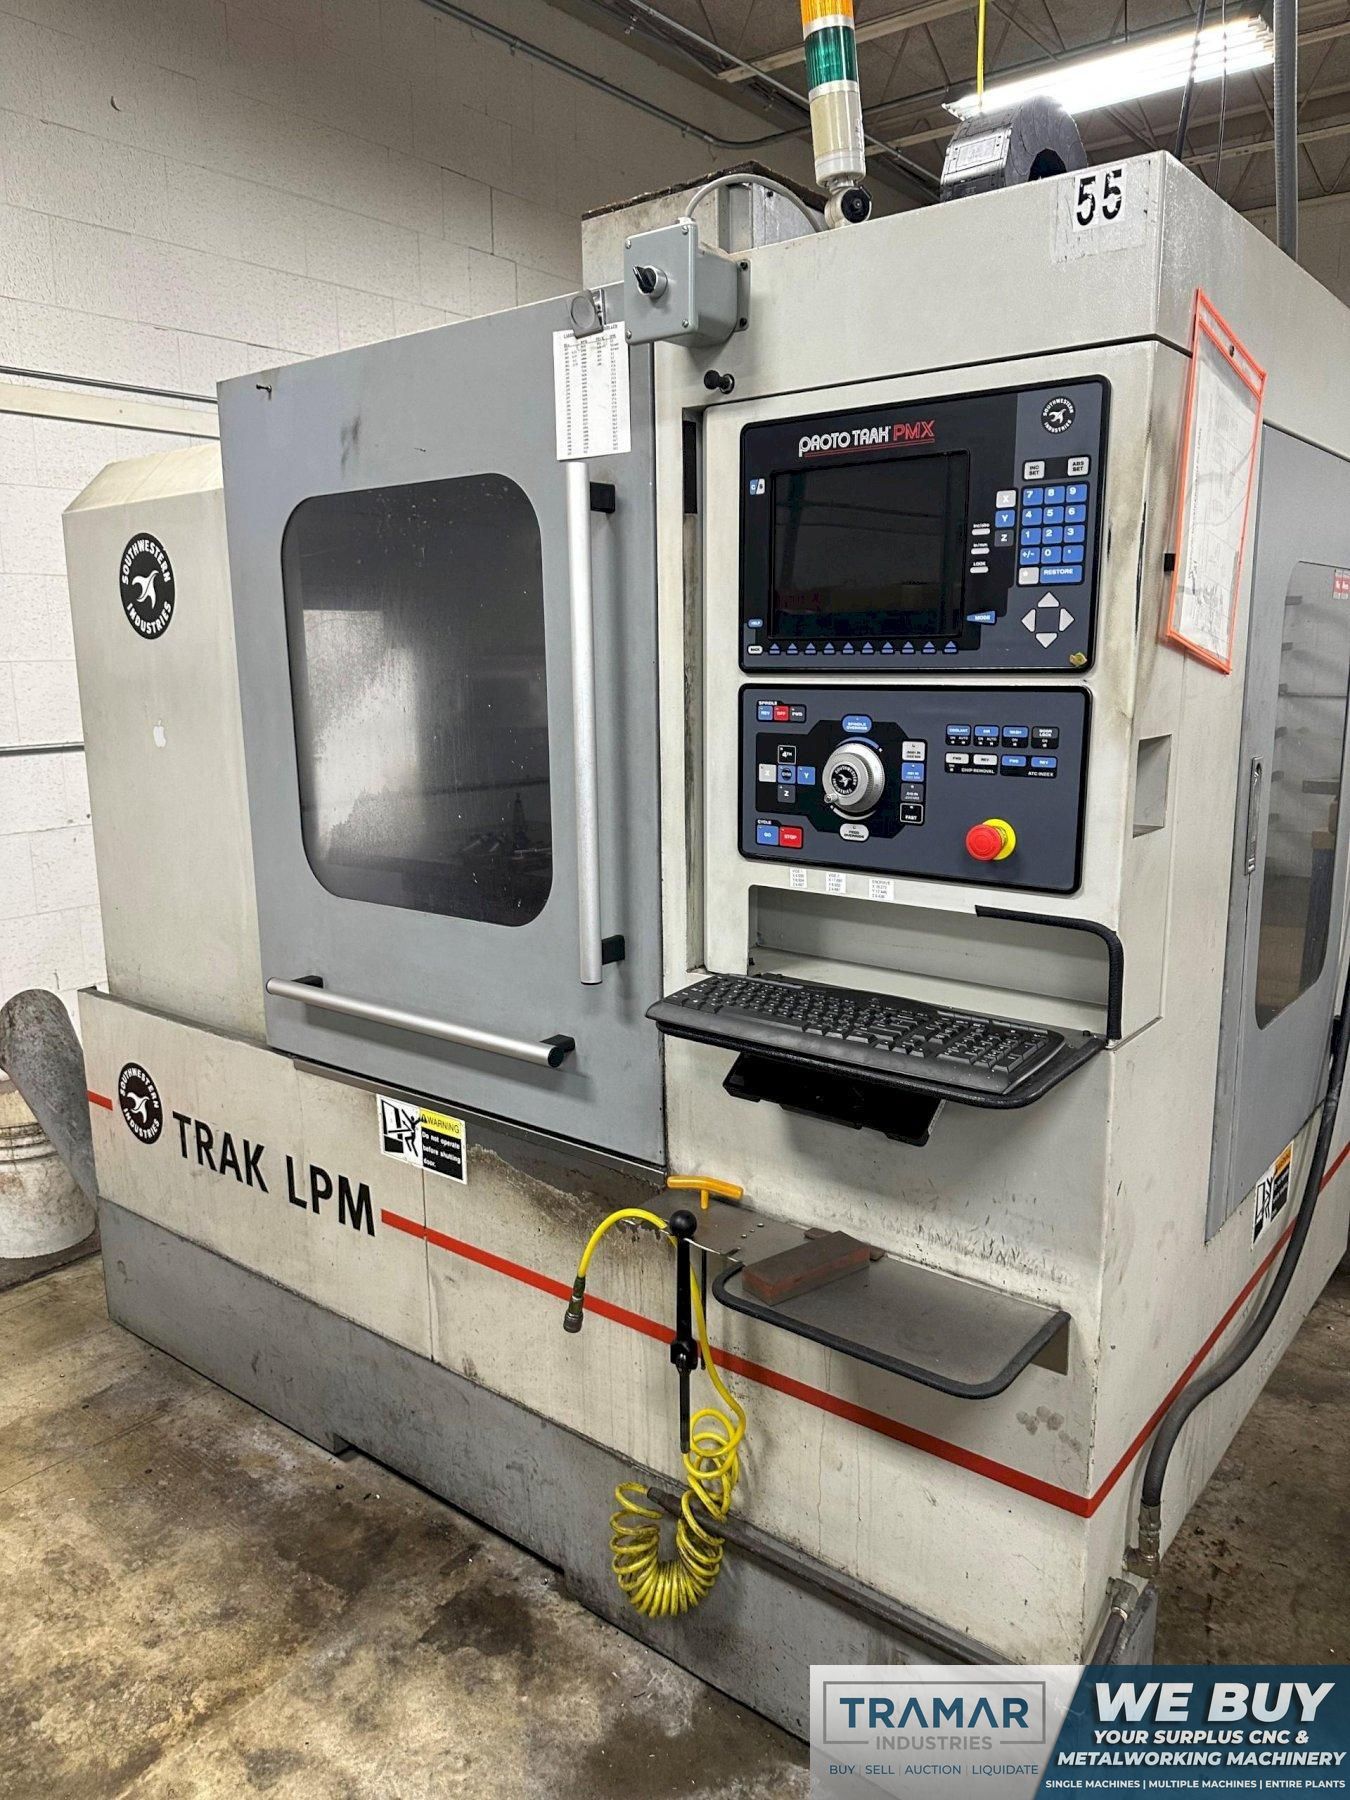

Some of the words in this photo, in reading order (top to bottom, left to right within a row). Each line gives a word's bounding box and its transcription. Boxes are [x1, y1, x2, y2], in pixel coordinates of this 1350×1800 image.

[1076, 168, 1122, 226] 55
[893, 420, 935, 441] PMX
[1002, 495, 1009, 503] X
[1070, 487, 1076, 495] 9
[1047, 509, 1054, 517] 5
[1001, 534, 1008, 542] Z
[1067, 528, 1074, 536] 3
[121, 539, 171, 585] SOUTHWESTERN
[1045, 549, 1051, 557] 0
[126, 601, 171, 635] INDUSTRIES
[119, 1068, 160, 1110] SOUTHWESTERN
[123, 1108, 160, 1139] INDUSTRIES
[427, 1116, 459, 1134] WARNING
[422, 1131, 429, 1139] Do
[431, 1135, 439, 1143] not
[440, 1137, 460, 1149] operate
[172, 1110, 269, 1194] TRAK
[285, 1154, 375, 1237] LPM
